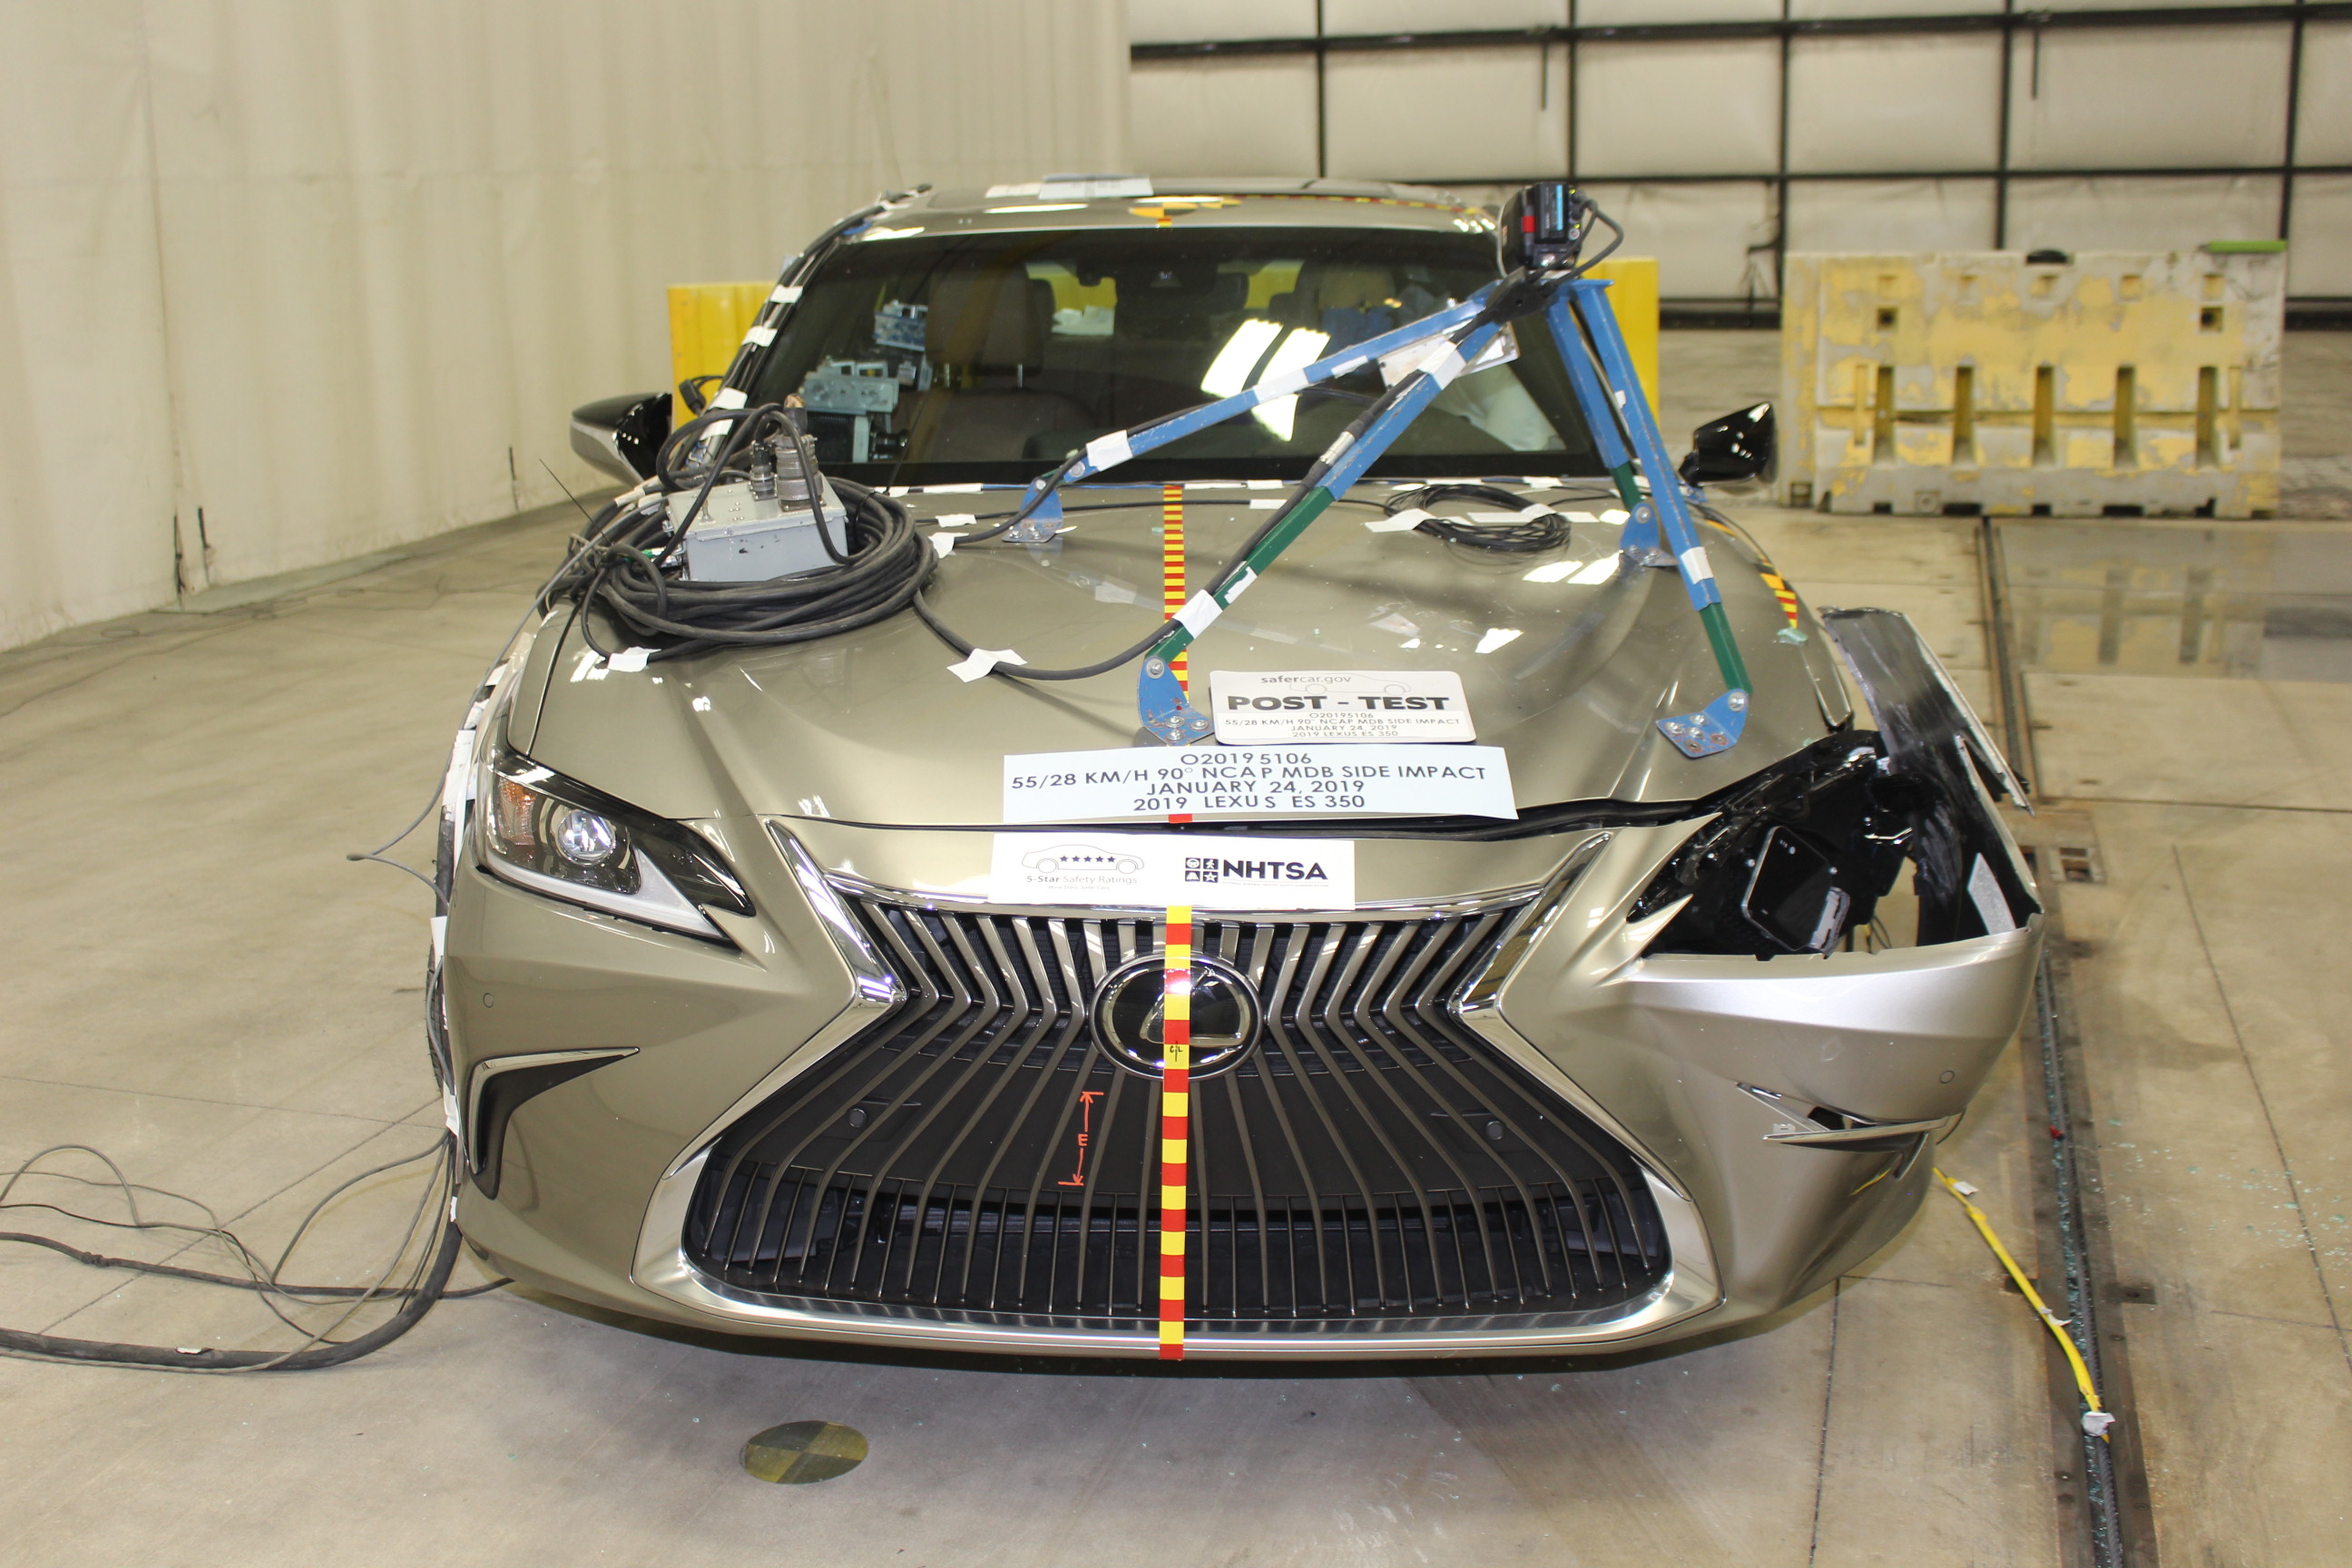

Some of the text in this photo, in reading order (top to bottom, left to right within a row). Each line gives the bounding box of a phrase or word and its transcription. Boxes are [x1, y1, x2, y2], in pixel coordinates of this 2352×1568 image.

[1261, 675, 1352, 685] safercar.gov
[1228, 695, 1328, 710] POST
[1357, 696, 1450, 710] TEST
[1225, 719, 1258, 727] 55/28
[1261, 719, 1294, 727] KM/H
[1011, 773, 1077, 789] 55/28
[1085, 769, 1149, 785] KM/H
[1202, 766, 1273, 779] NCAP
[1282, 766, 1335, 779] MDB
[1341, 766, 1391, 779] SIDE
[1397, 766, 1486, 780] IMPACT
[1146, 779, 1365, 796] JANUARY 24, 2019
[1133, 795, 1366, 811] 2019 LEXUS ES 350
[1222, 859, 1328, 880] NHTSA
[1026, 875, 1138, 886] 5-Star Safety Ratings
[1077, 1133, 1089, 1147] E
